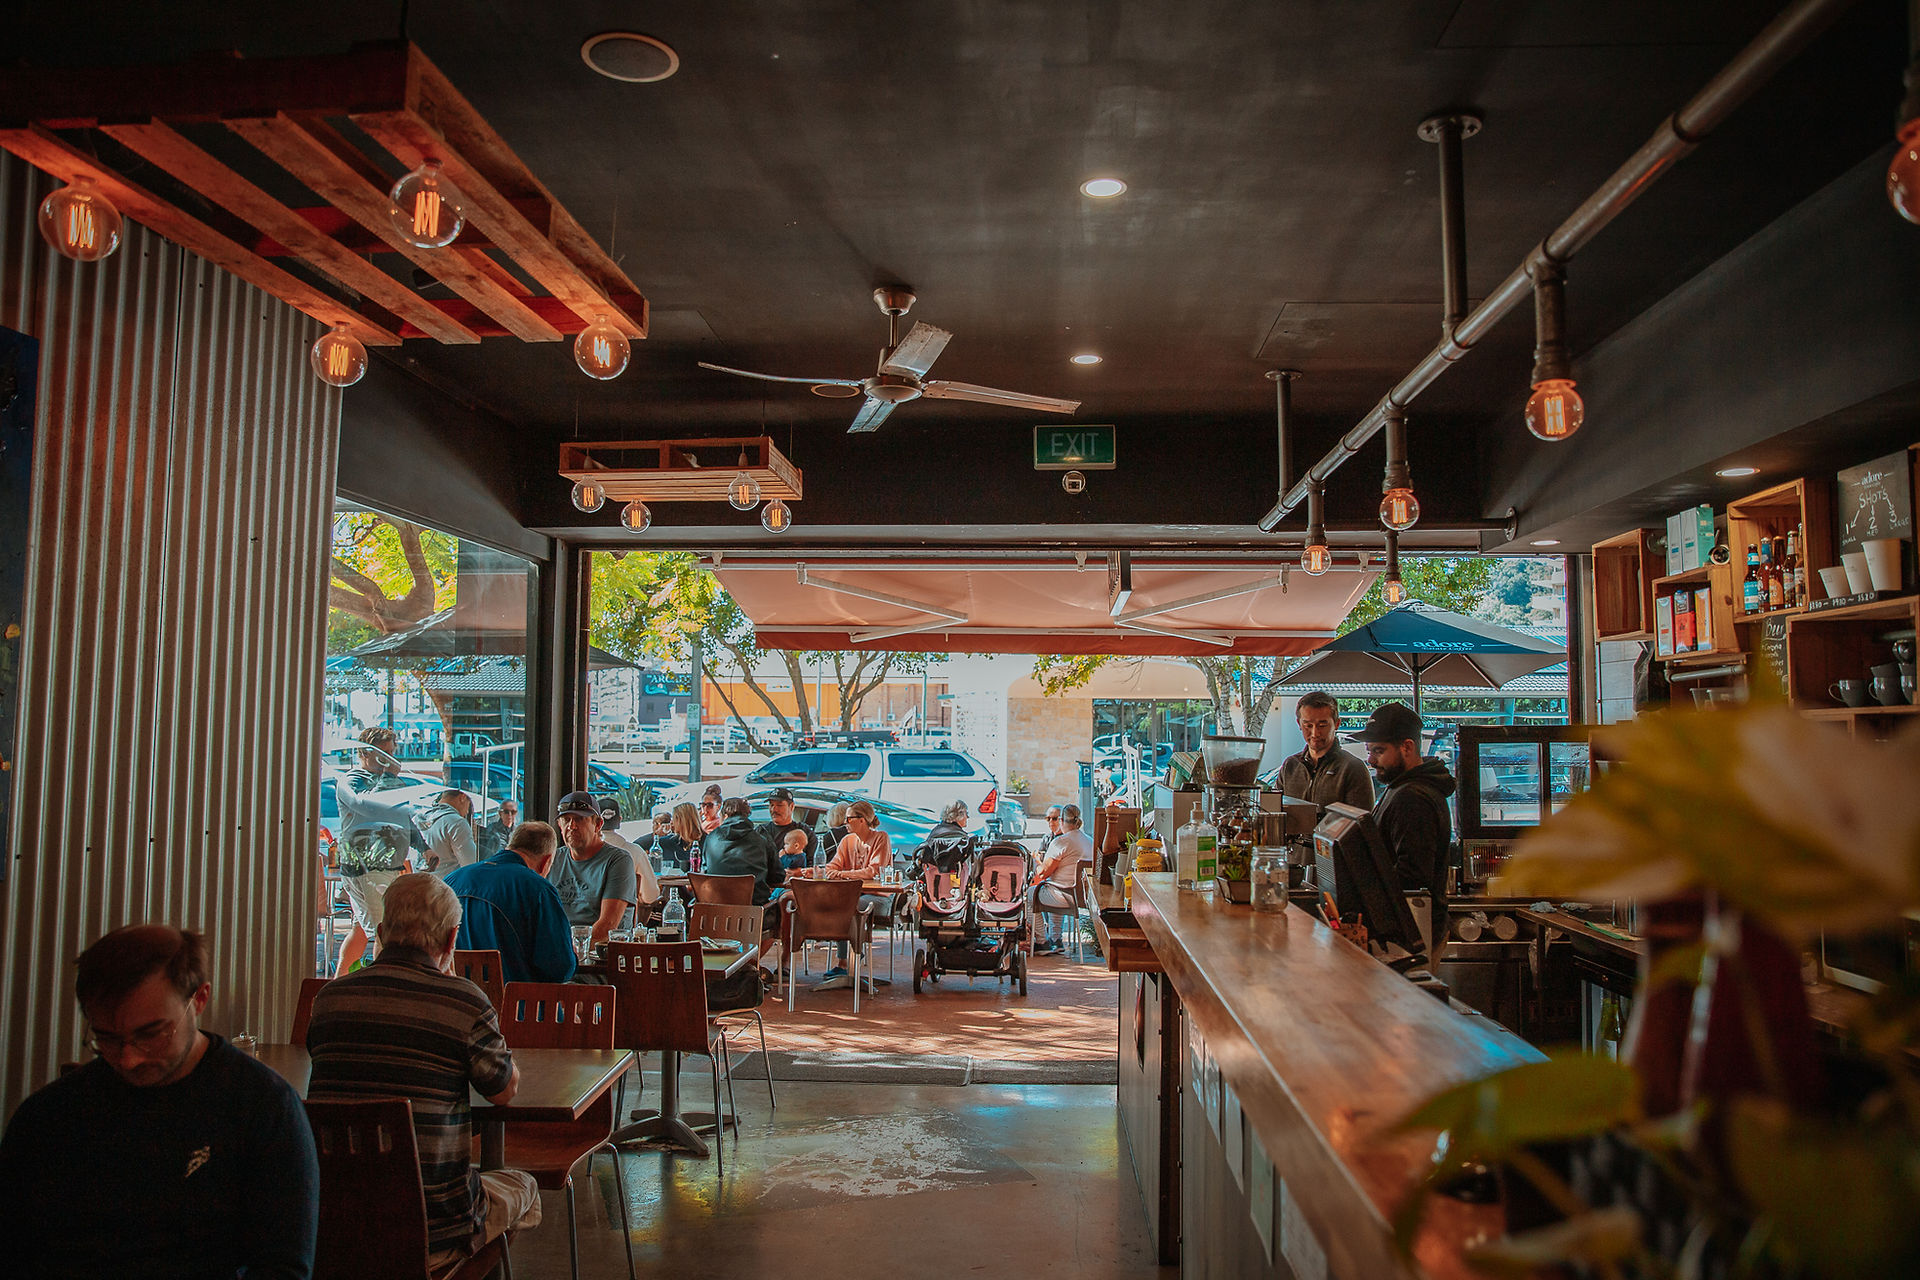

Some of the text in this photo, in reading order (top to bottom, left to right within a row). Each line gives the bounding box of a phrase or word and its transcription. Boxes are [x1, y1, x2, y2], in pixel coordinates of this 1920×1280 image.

[1051, 433, 1099, 456] EXIT
[1889, 510, 1897, 523] 3
[1868, 517, 1877, 530] 2
[1413, 639, 1475, 648] adore
[1083, 767, 1091, 776] P
